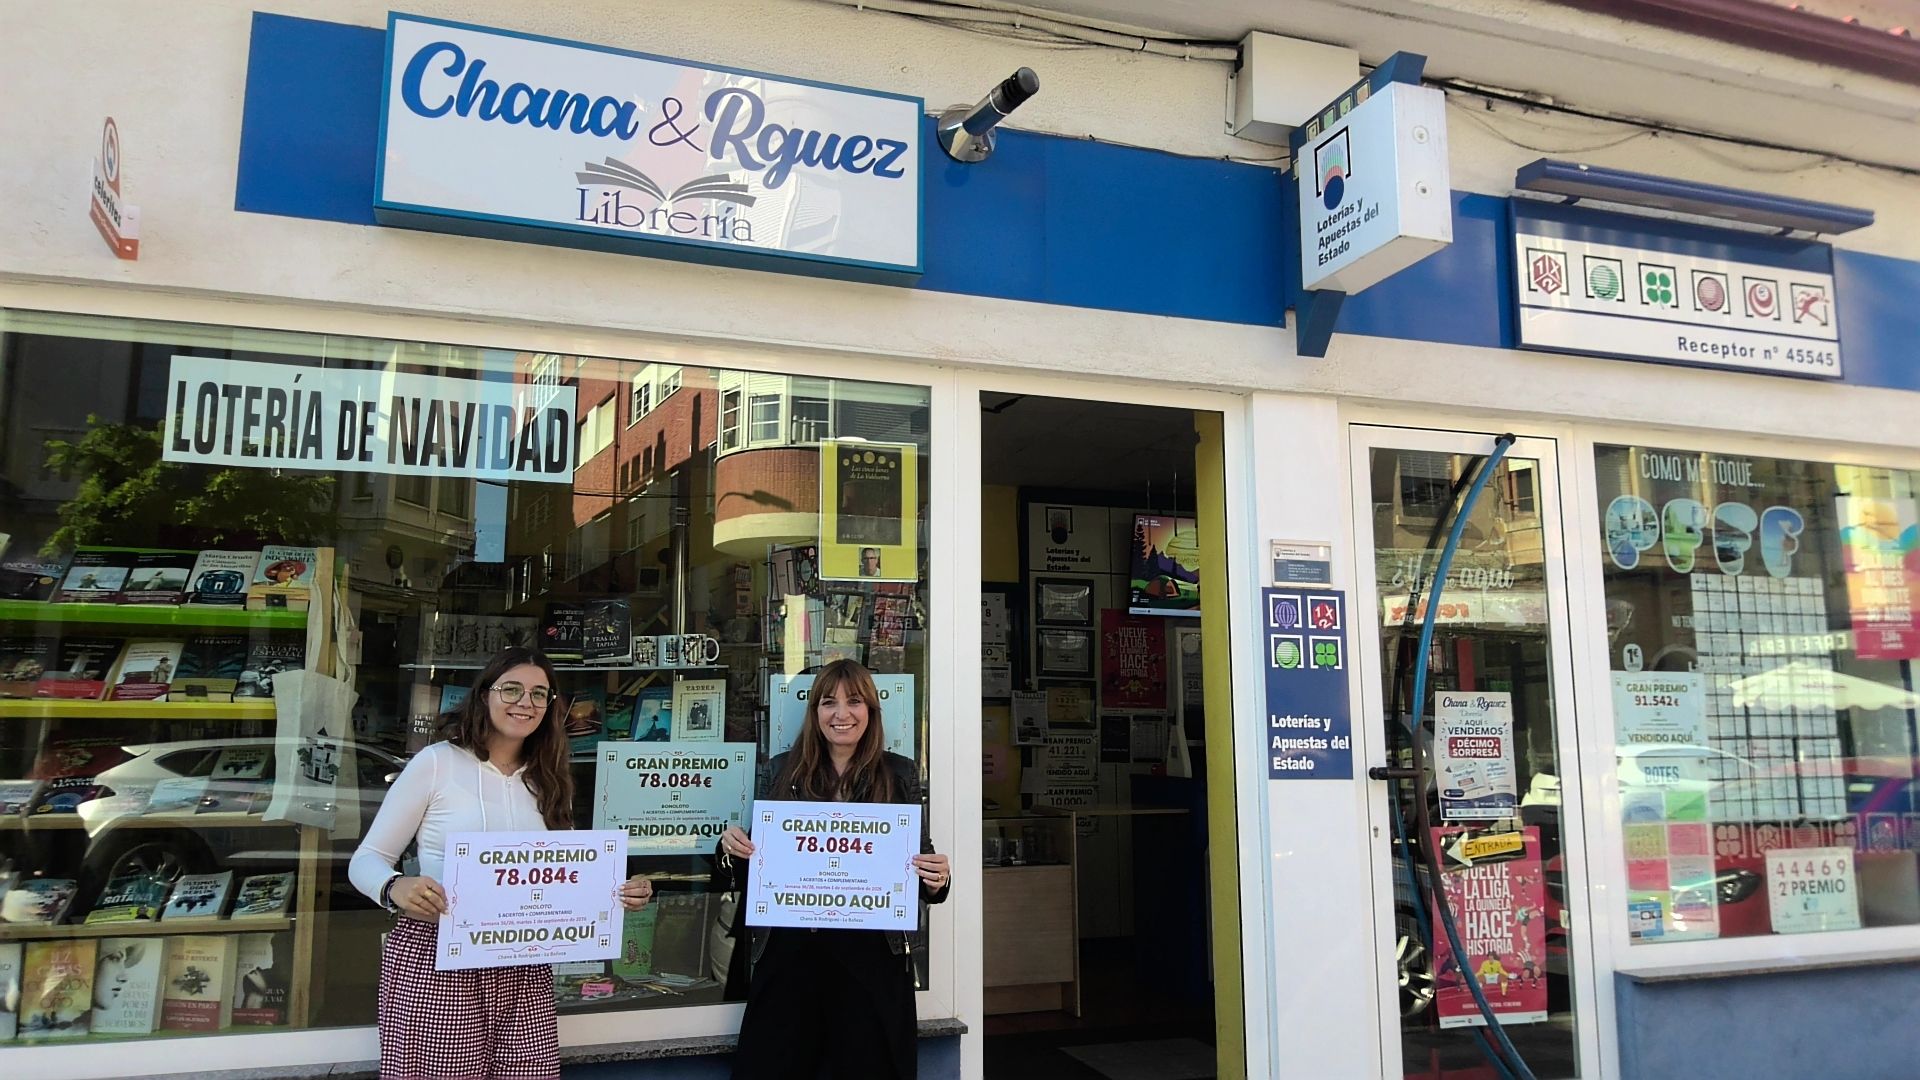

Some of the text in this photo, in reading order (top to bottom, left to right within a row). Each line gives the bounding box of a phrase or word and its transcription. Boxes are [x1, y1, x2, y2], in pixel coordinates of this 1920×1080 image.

[401, 41, 908, 190] Chana & Rguez
[576, 187, 756, 244] Librería
[1317, 197, 1363, 233] Loterías y
[1318, 203, 1379, 250] Apuestas del
[1318, 240, 1350, 267] Estado
[1678, 336, 1755, 359] Receptor
[1786, 349, 1835, 368] 45545
[172, 373, 570, 475] LOTERÍA DE NAVIDAD
[1641, 453, 1681, 482] COMO
[1710, 460, 1766, 488] TOQUE...
[1046, 547, 1075, 555] Loterías
[1118, 627, 1149, 638] VUELVE
[1119, 638, 1130, 648] LA
[1119, 654, 1149, 669] HACE
[1626, 683, 1689, 694] GRAN PREMIO
[1442, 696, 1468, 708] Chana
[1271, 714, 1331, 732] Loterías y
[1448, 727, 1504, 736] VENDEMOS
[1464, 719, 1484, 727] AQUÍ
[1272, 734, 1350, 752] Apuestas del
[1457, 737, 1494, 748] DÉCIMO
[1627, 730, 1694, 744] VENDIDO AQUÍ
[1452, 749, 1500, 757] SORPRESA
[626, 758, 729, 770] GRAN PREMIO
[1273, 756, 1315, 770] Estado
[782, 819, 891, 835] GRAN PREMIO
[479, 848, 598, 865] GRAN PREMIO
[1464, 838, 1512, 858] ENTRADA
[1463, 863, 1510, 881] VUELVE
[1463, 880, 1480, 899] LA
[1791, 878, 1846, 896] PREMIO
[519, 903, 553, 911] BONOLOTO
[774, 891, 891, 910] VENDIDO AQUÍ
[1464, 899, 1475, 912] LA
[470, 920, 596, 946] VENDIDO AQUÍ
[1465, 911, 1513, 939] HACE
[1466, 938, 1515, 956] HISTORIA
